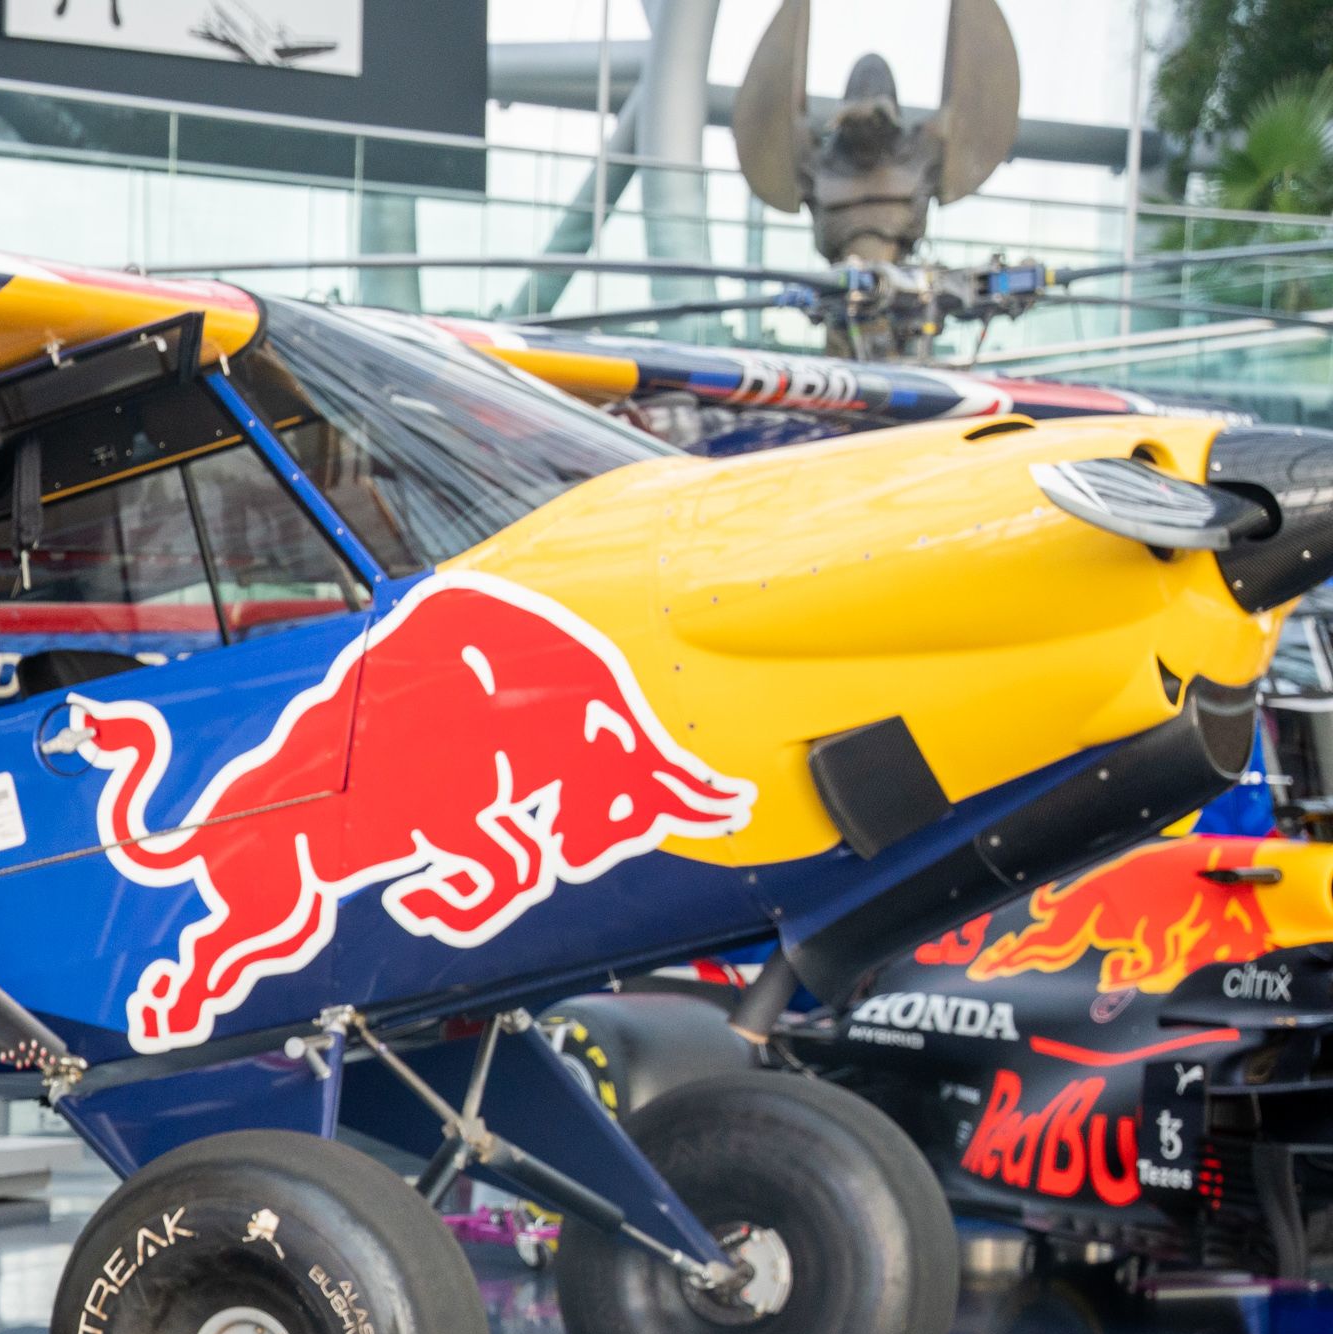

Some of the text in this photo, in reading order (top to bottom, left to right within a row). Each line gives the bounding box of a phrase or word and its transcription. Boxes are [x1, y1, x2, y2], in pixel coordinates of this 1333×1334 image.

[1222, 963, 1293, 1002] citrix
[851, 991, 1021, 1042] HONDA
[1036, 1077, 1142, 1207] Bu
[1137, 1160, 1193, 1191] Tezos
